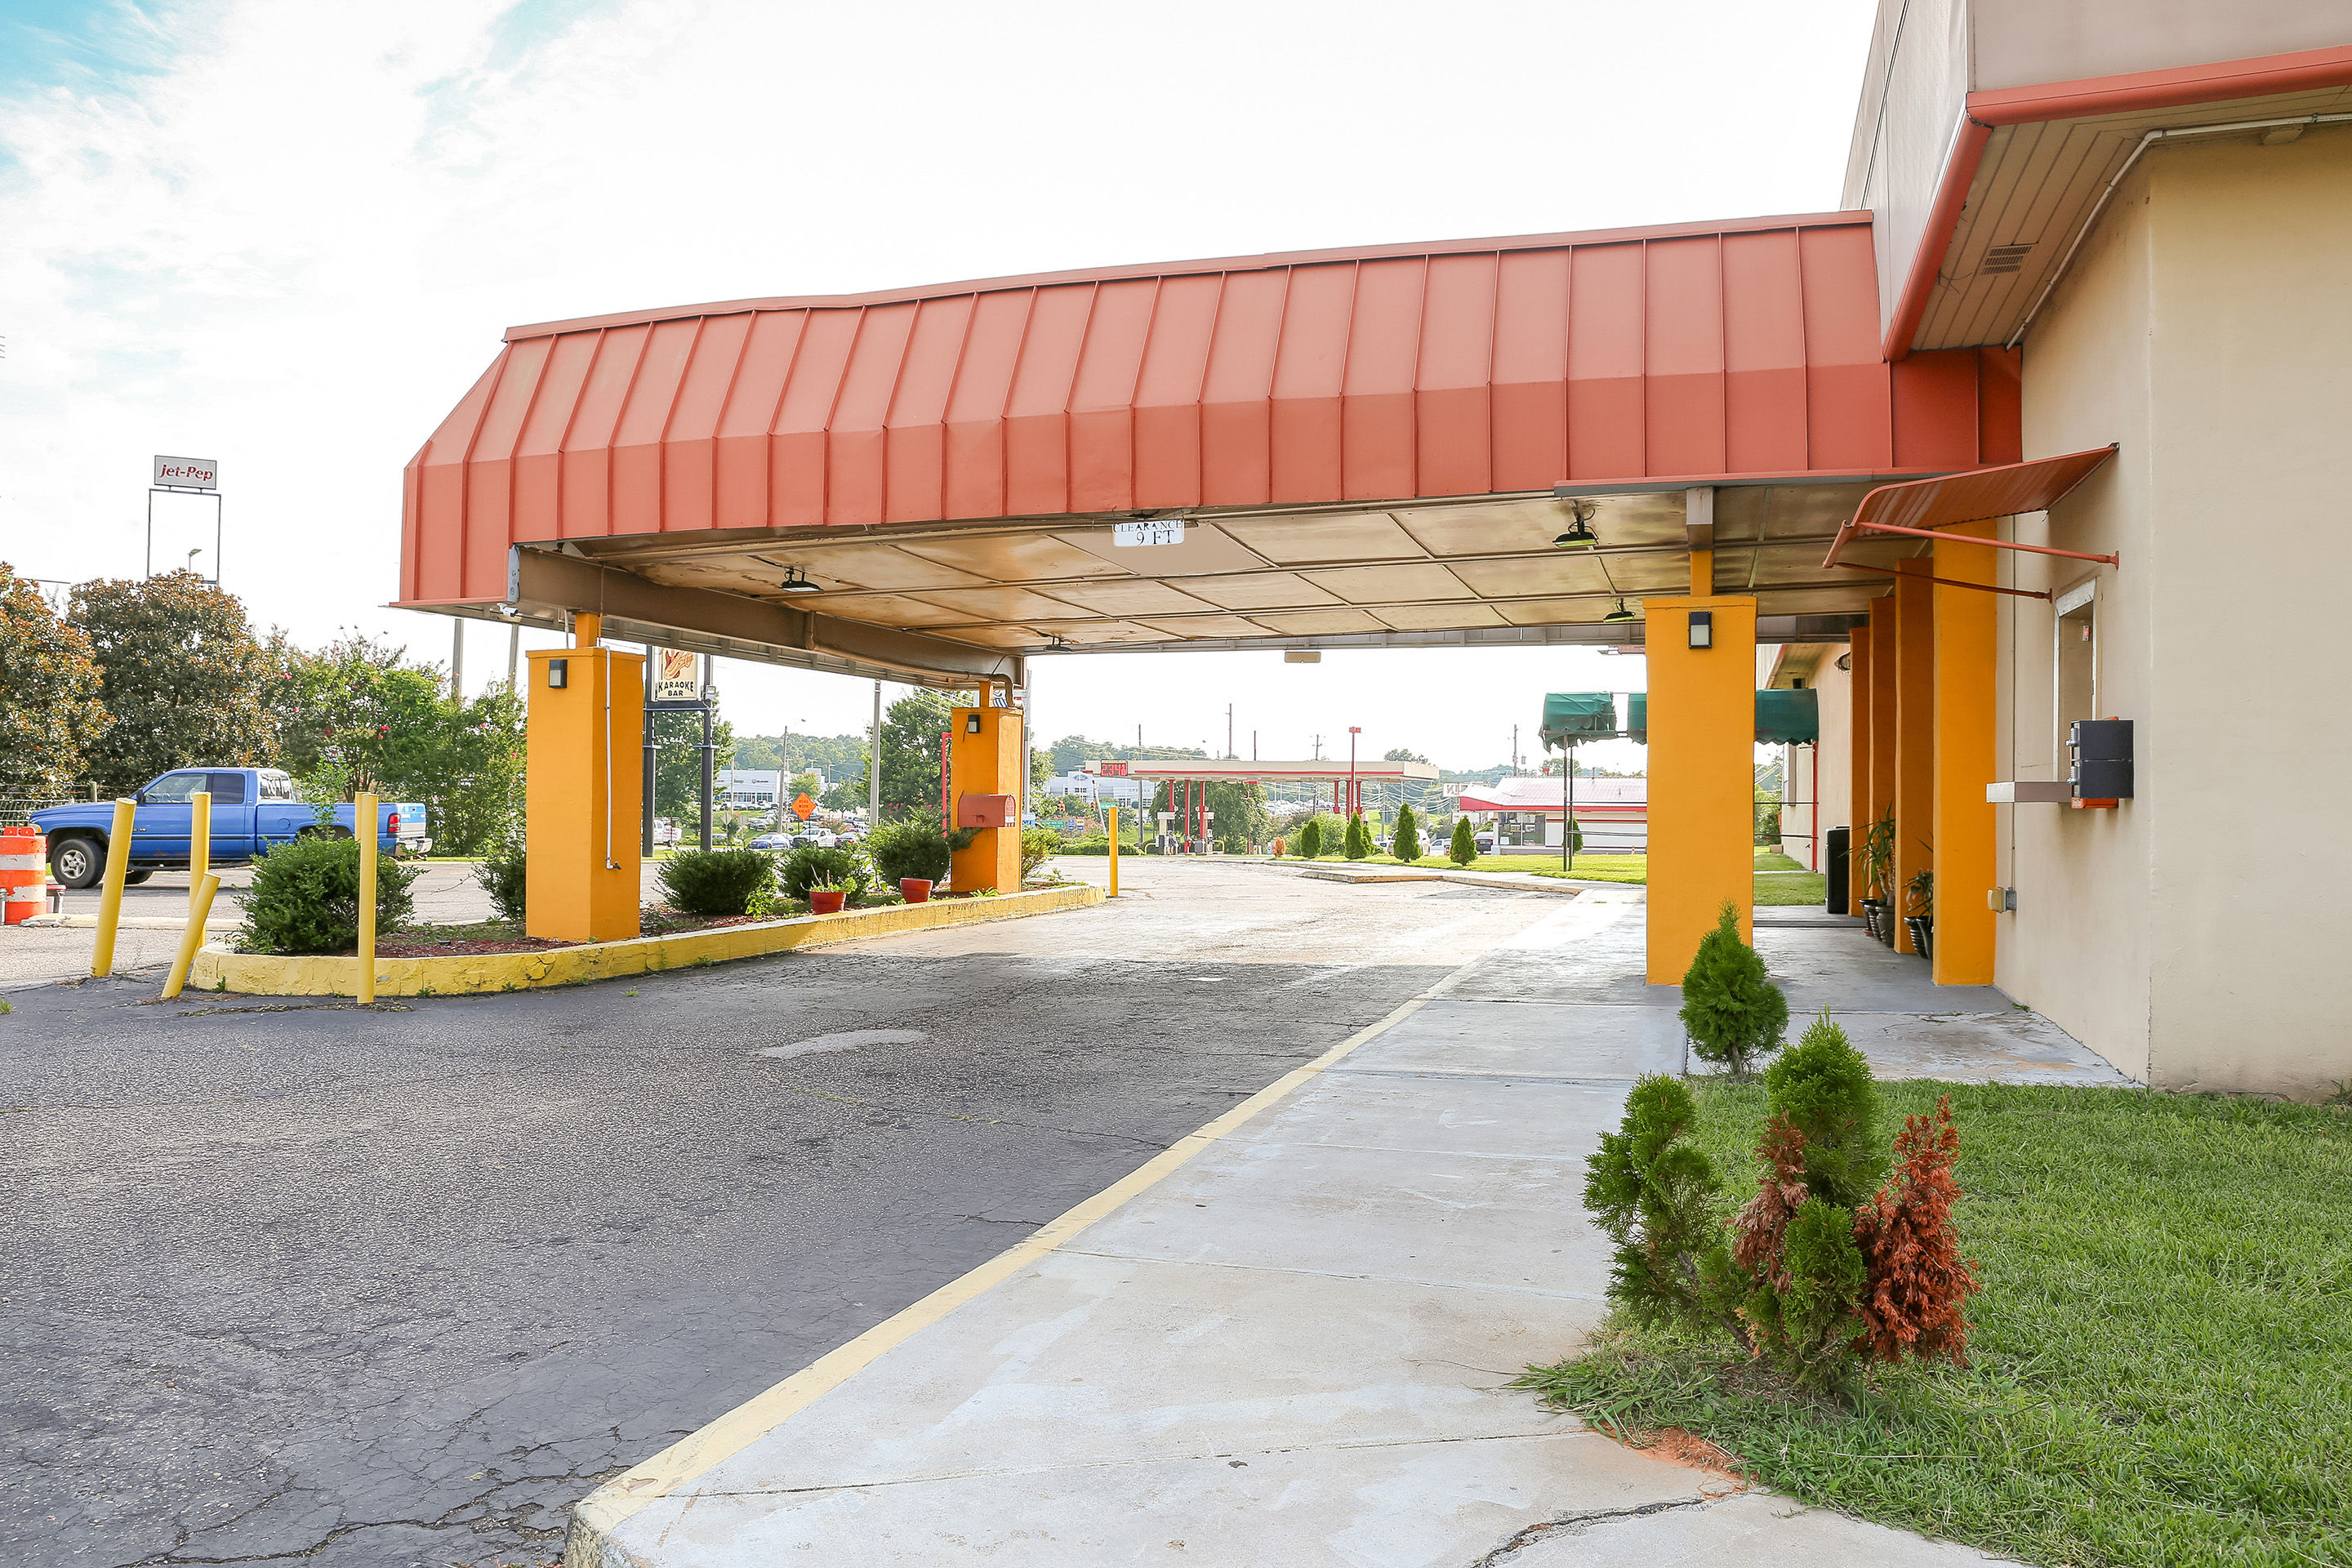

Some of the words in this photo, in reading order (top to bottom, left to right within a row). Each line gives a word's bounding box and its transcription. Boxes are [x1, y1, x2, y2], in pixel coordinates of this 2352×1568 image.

[158, 464, 213, 481] jet-Pep
[1113, 519, 1183, 532] CLEARANCE
[1136, 532, 1144, 546] 9
[1152, 530, 1174, 545] FT
[658, 681, 693, 693] KARAOKE
